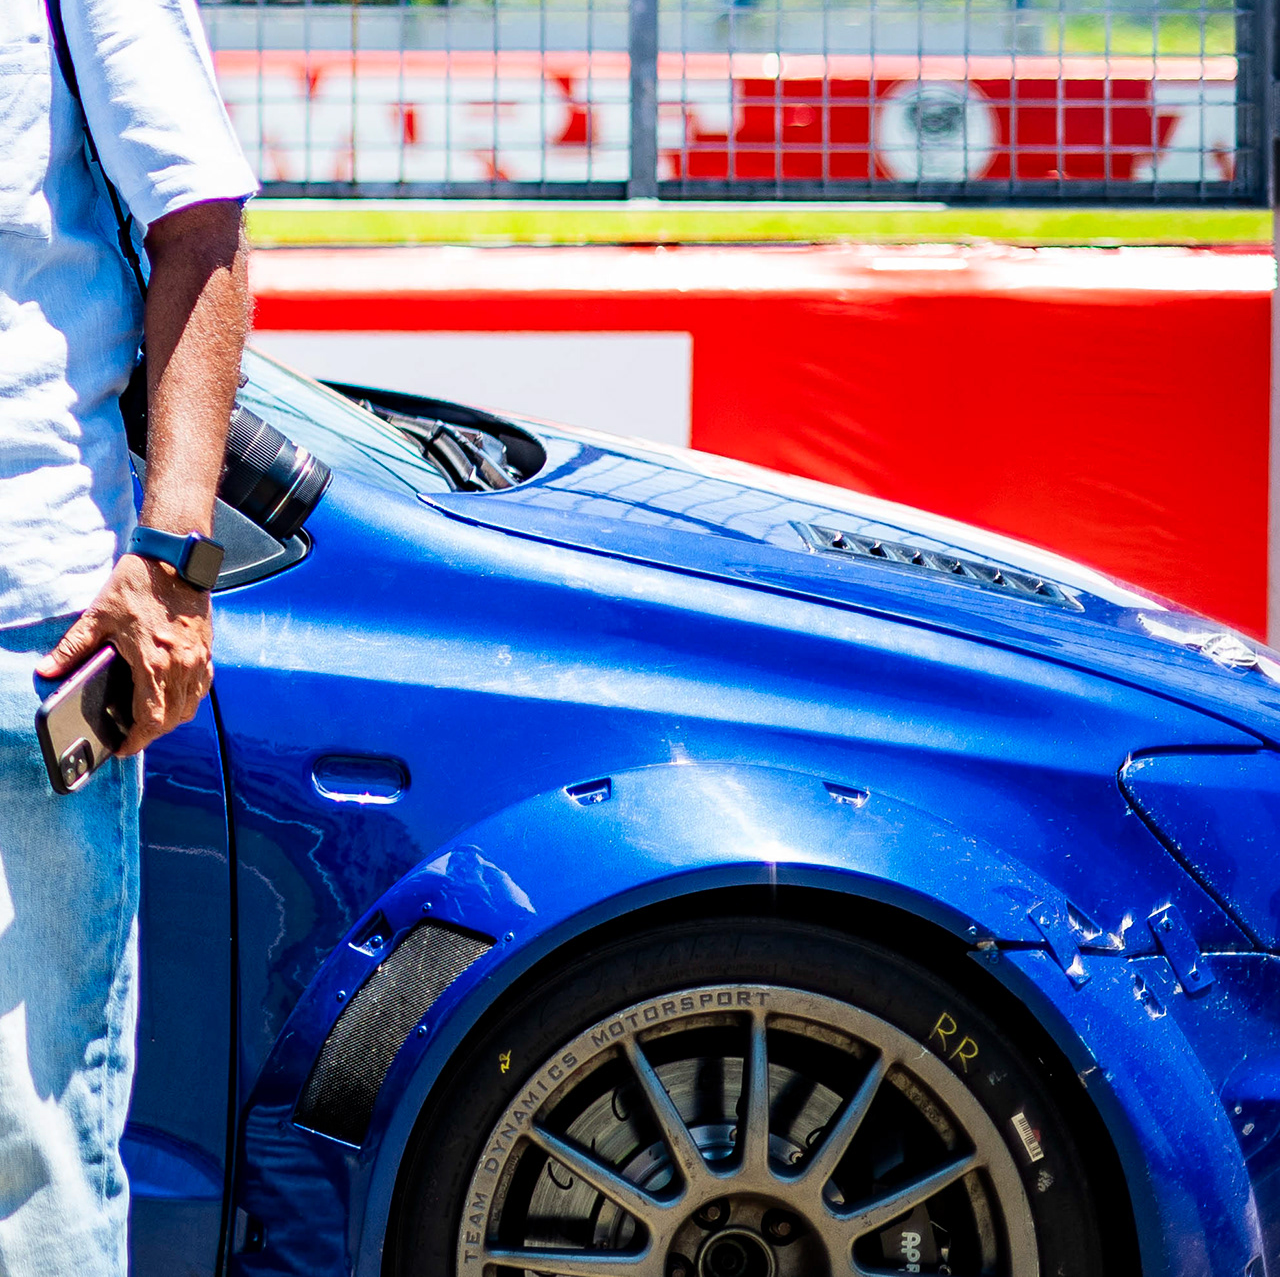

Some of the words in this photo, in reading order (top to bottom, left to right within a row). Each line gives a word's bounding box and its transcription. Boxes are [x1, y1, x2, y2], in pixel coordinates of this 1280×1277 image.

[928, 1012, 980, 1073] RR
[463, 1190, 488, 1264] TEAM
[484, 1051, 579, 1175] DYNAMICS
[591, 990, 771, 1049] MOTORSPORT
